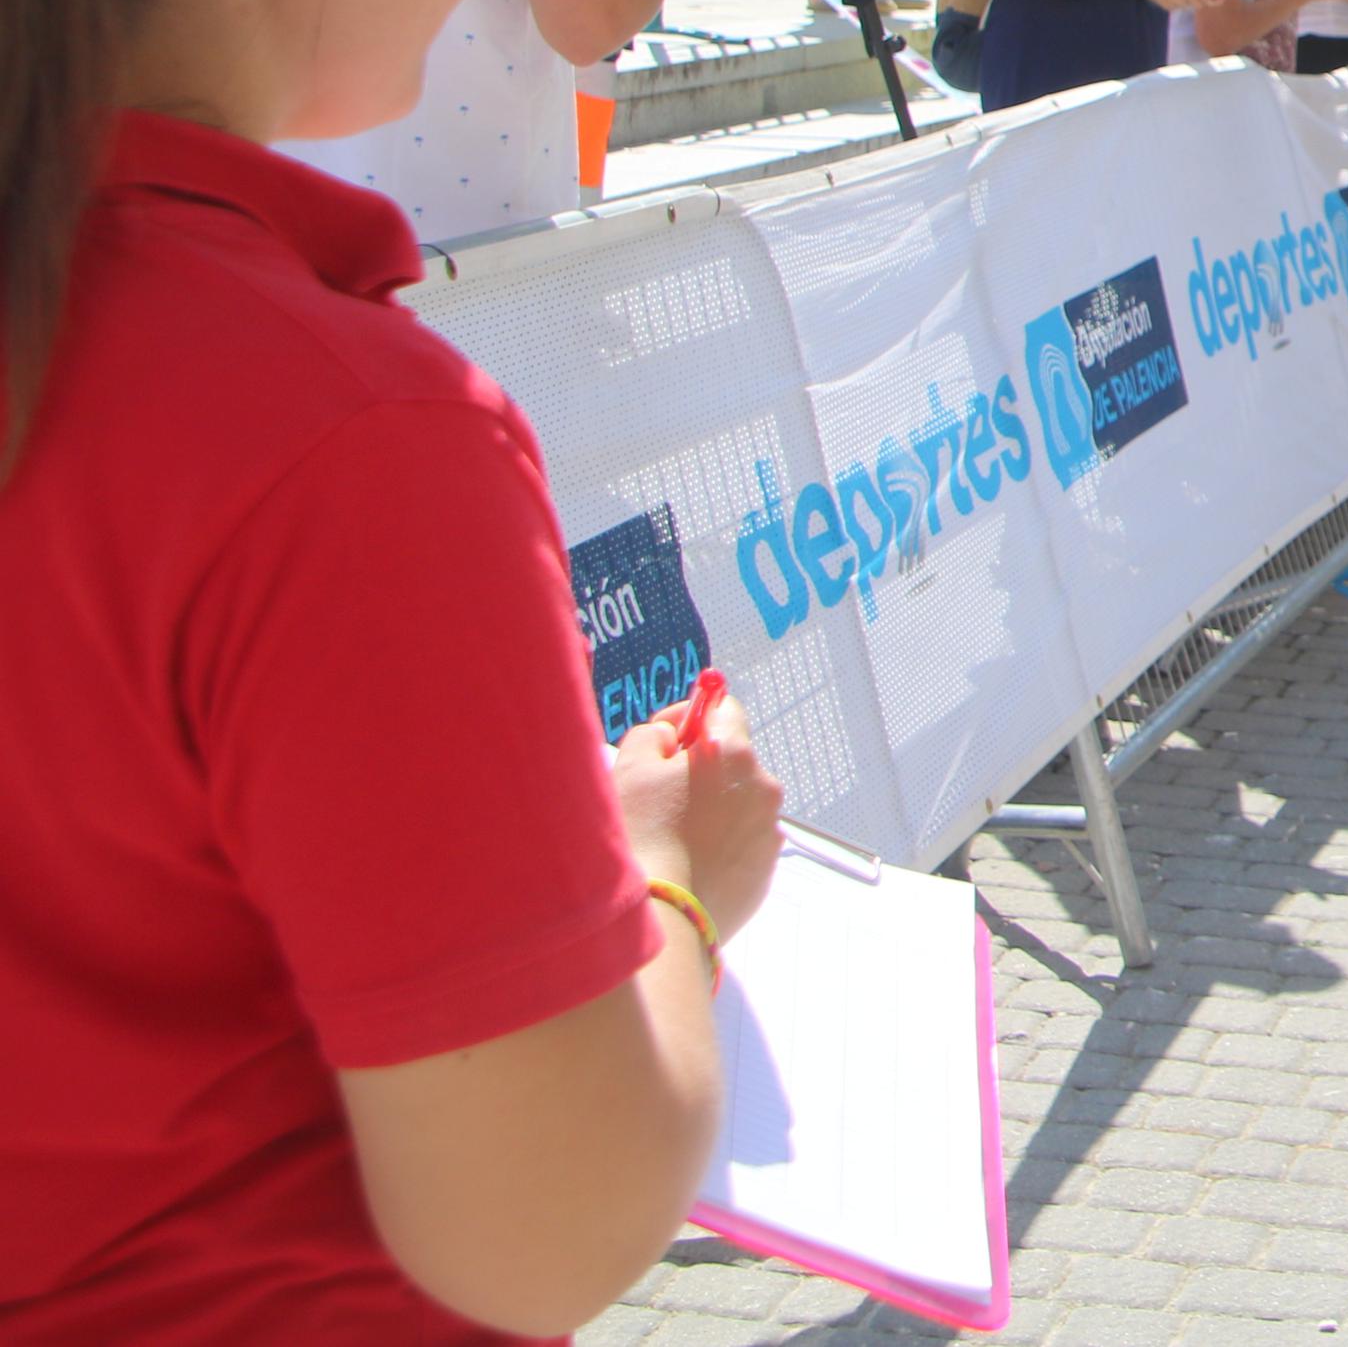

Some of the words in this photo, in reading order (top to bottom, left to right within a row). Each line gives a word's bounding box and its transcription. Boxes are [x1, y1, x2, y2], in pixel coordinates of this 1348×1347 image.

[1076, 296, 1153, 369] Diputación
[1189, 211, 1338, 362] deportes
[1093, 382, 1118, 430] DE
[1110, 344, 1181, 417] PALENCIA
[736, 374, 1031, 641] deportes
